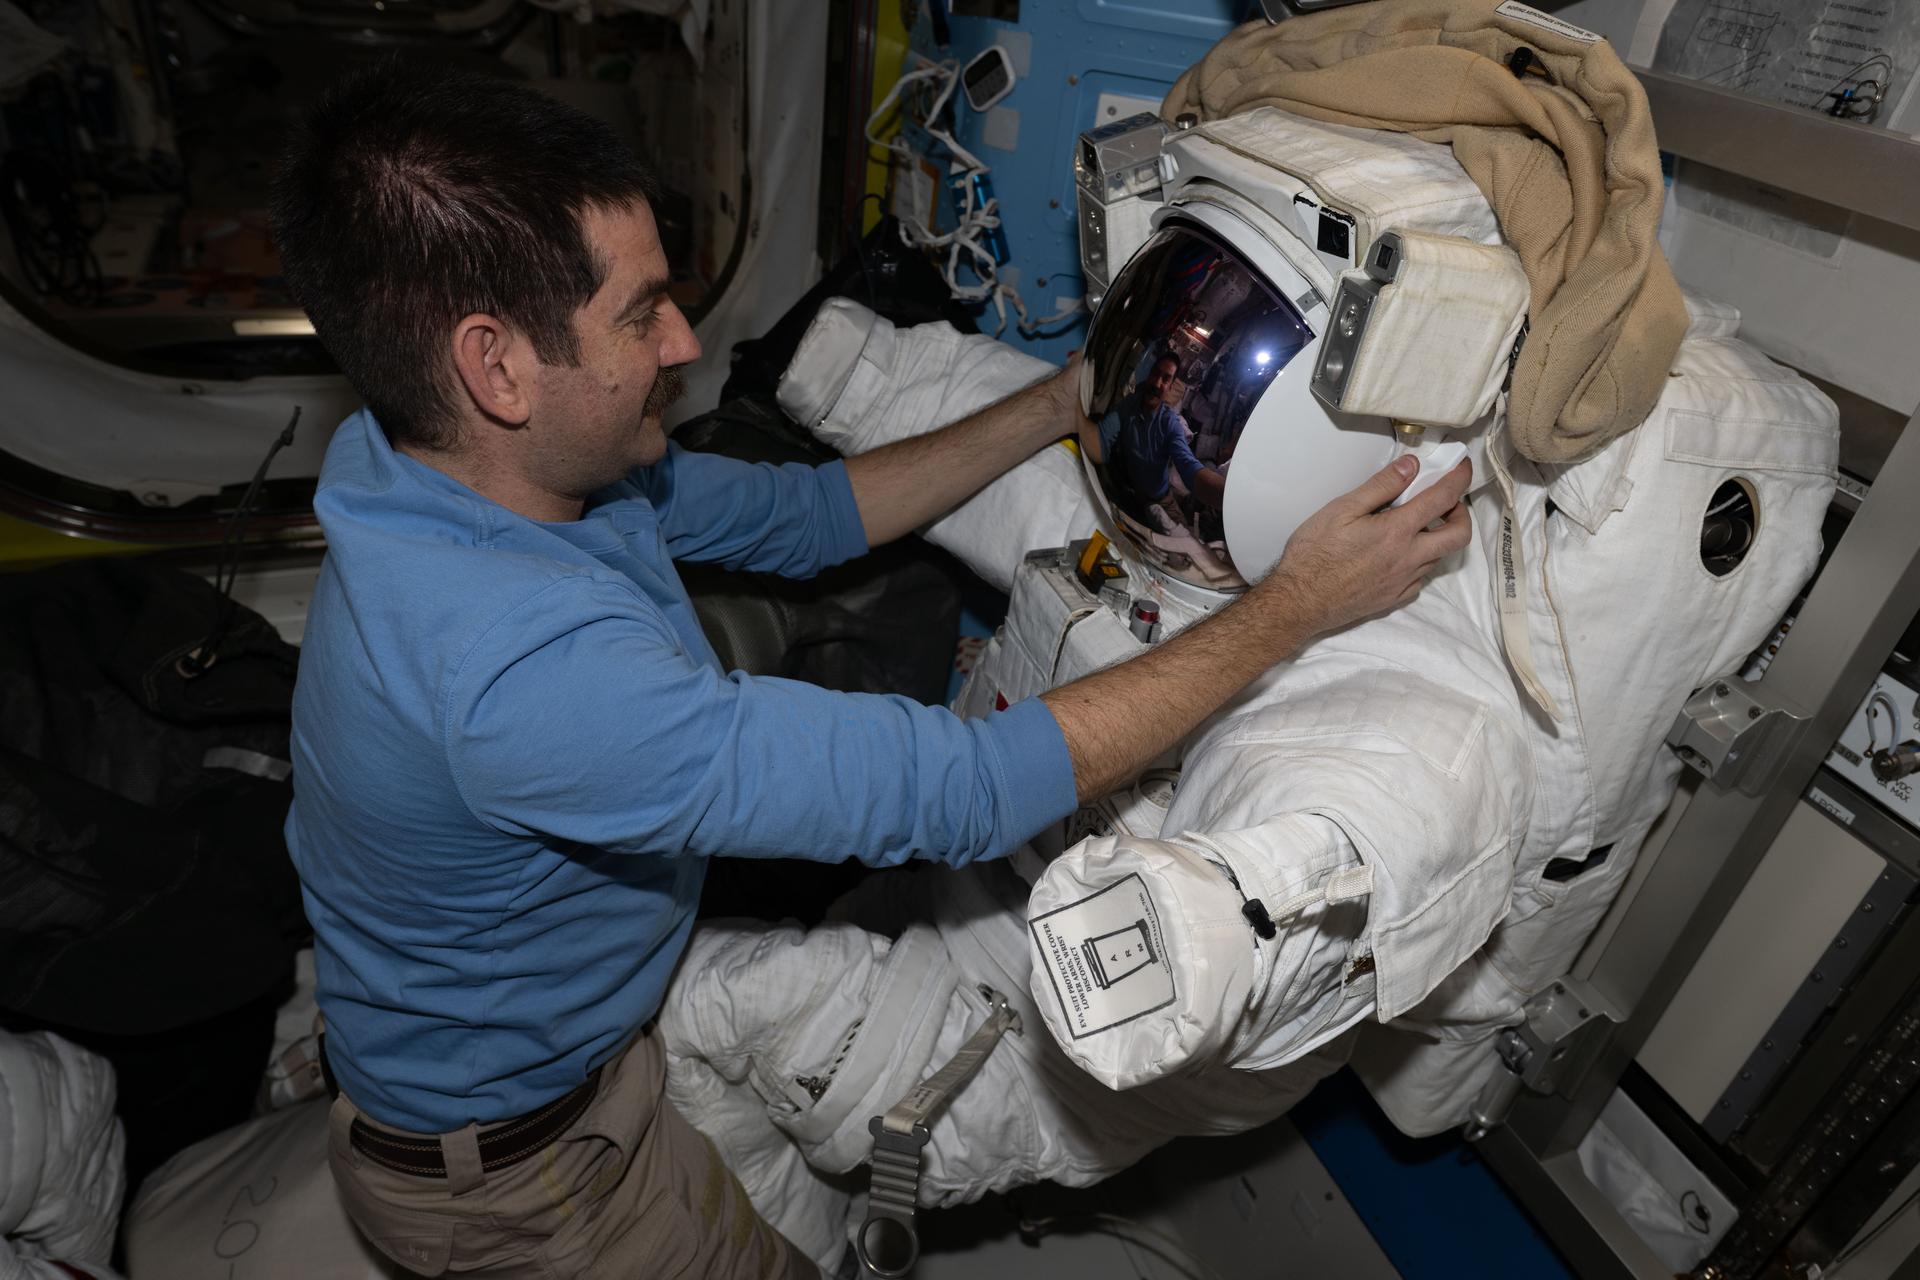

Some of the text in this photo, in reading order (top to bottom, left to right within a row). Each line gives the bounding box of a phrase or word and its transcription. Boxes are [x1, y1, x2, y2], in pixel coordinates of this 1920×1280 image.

[1503, 516, 1512, 534] P/N
[1890, 786, 1910, 803] MAX
[1056, 935, 1069, 959] WRIST
[1043, 923, 1087, 1029] EVA SUIT PROTECTIVE COVER
[1070, 946, 1093, 993] DISCONNECT
[1075, 981, 1090, 1010] LOWER
